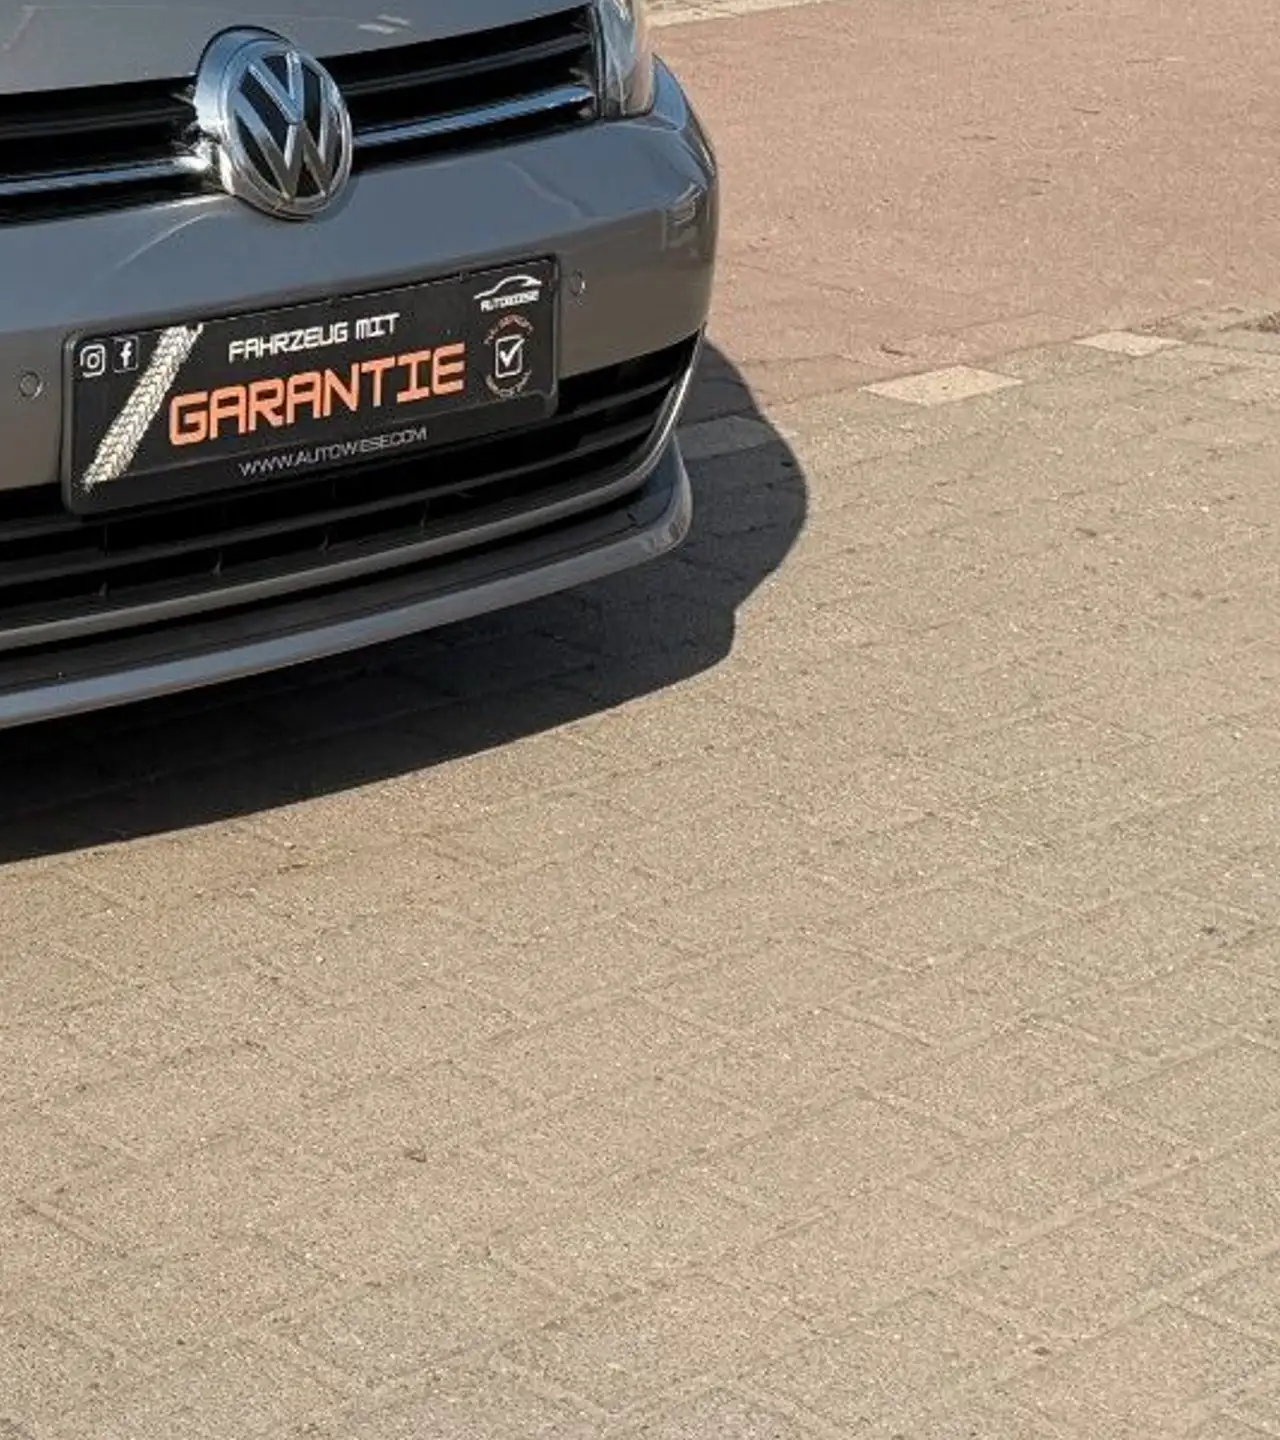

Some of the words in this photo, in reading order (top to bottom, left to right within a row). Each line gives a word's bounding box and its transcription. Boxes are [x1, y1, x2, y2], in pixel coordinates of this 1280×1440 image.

[229, 326, 348, 363] FAHRZEUG
[355, 312, 400, 340] MIT
[169, 343, 465, 446] GARANTIE
